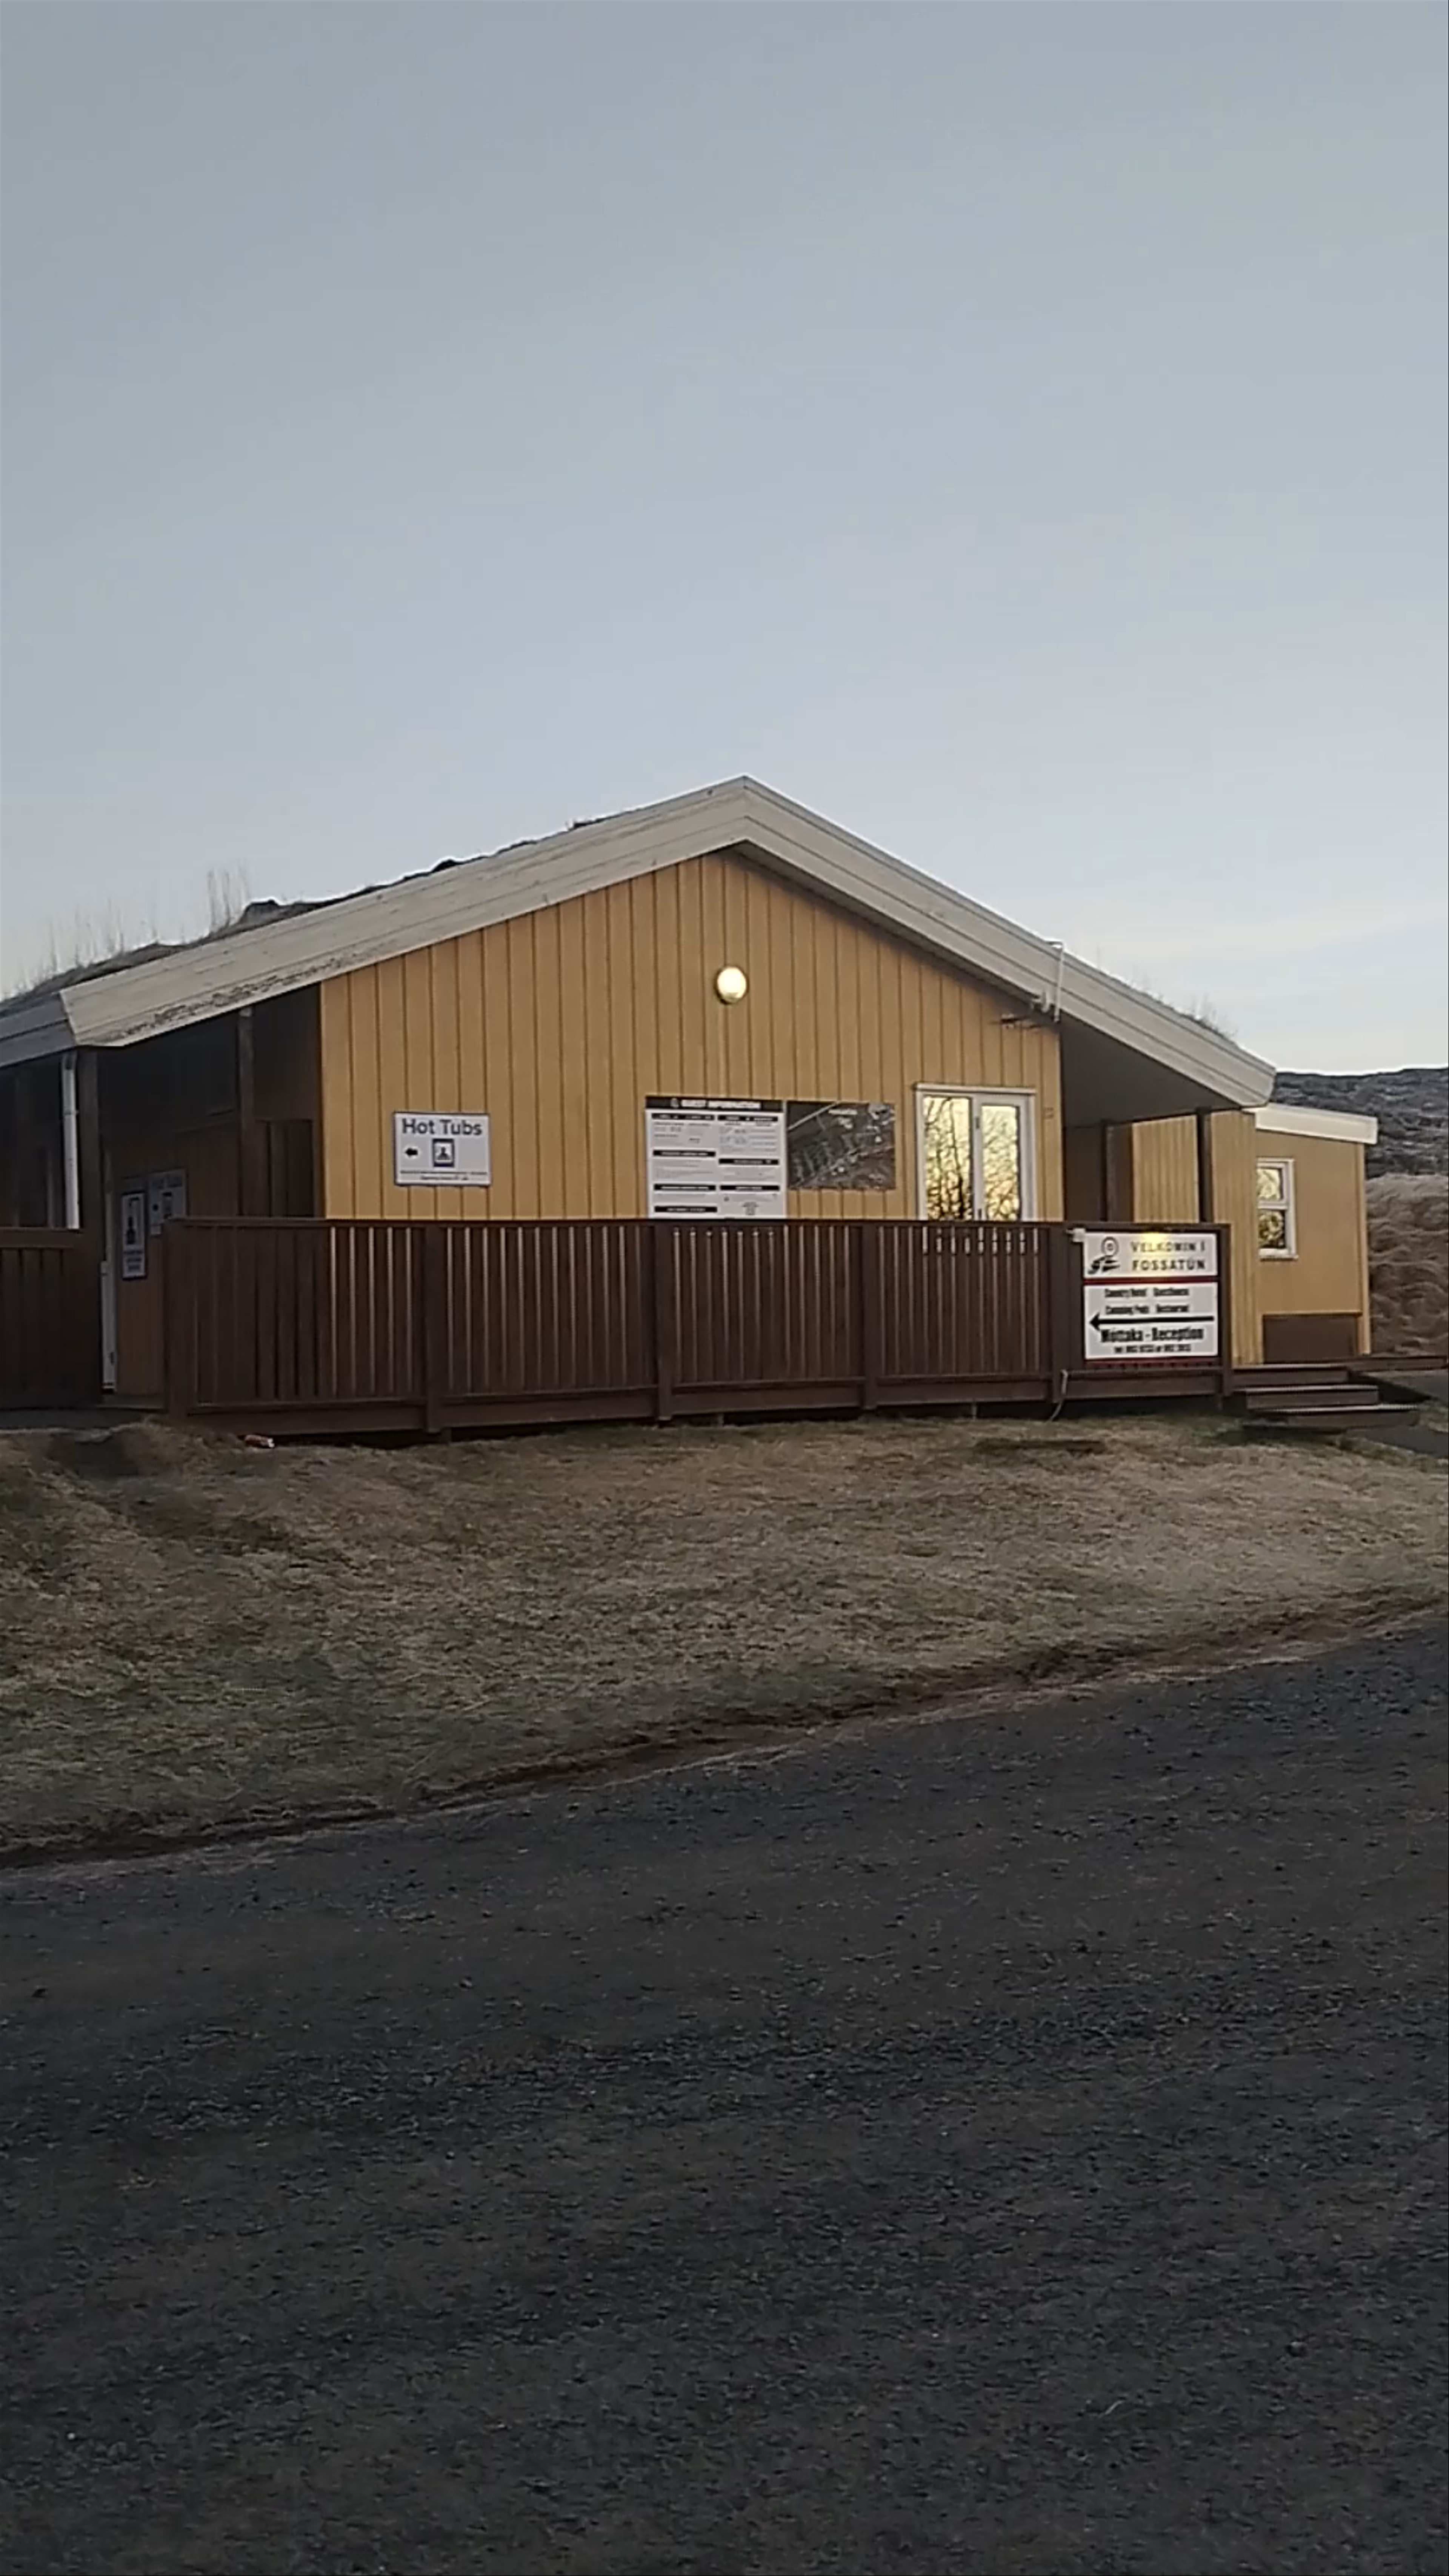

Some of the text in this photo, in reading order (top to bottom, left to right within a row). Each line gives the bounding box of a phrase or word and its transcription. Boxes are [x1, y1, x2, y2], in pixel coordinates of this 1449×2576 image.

[402, 1118, 482, 1135] Hot Tubs
[1152, 1327, 1204, 1342] Reception
